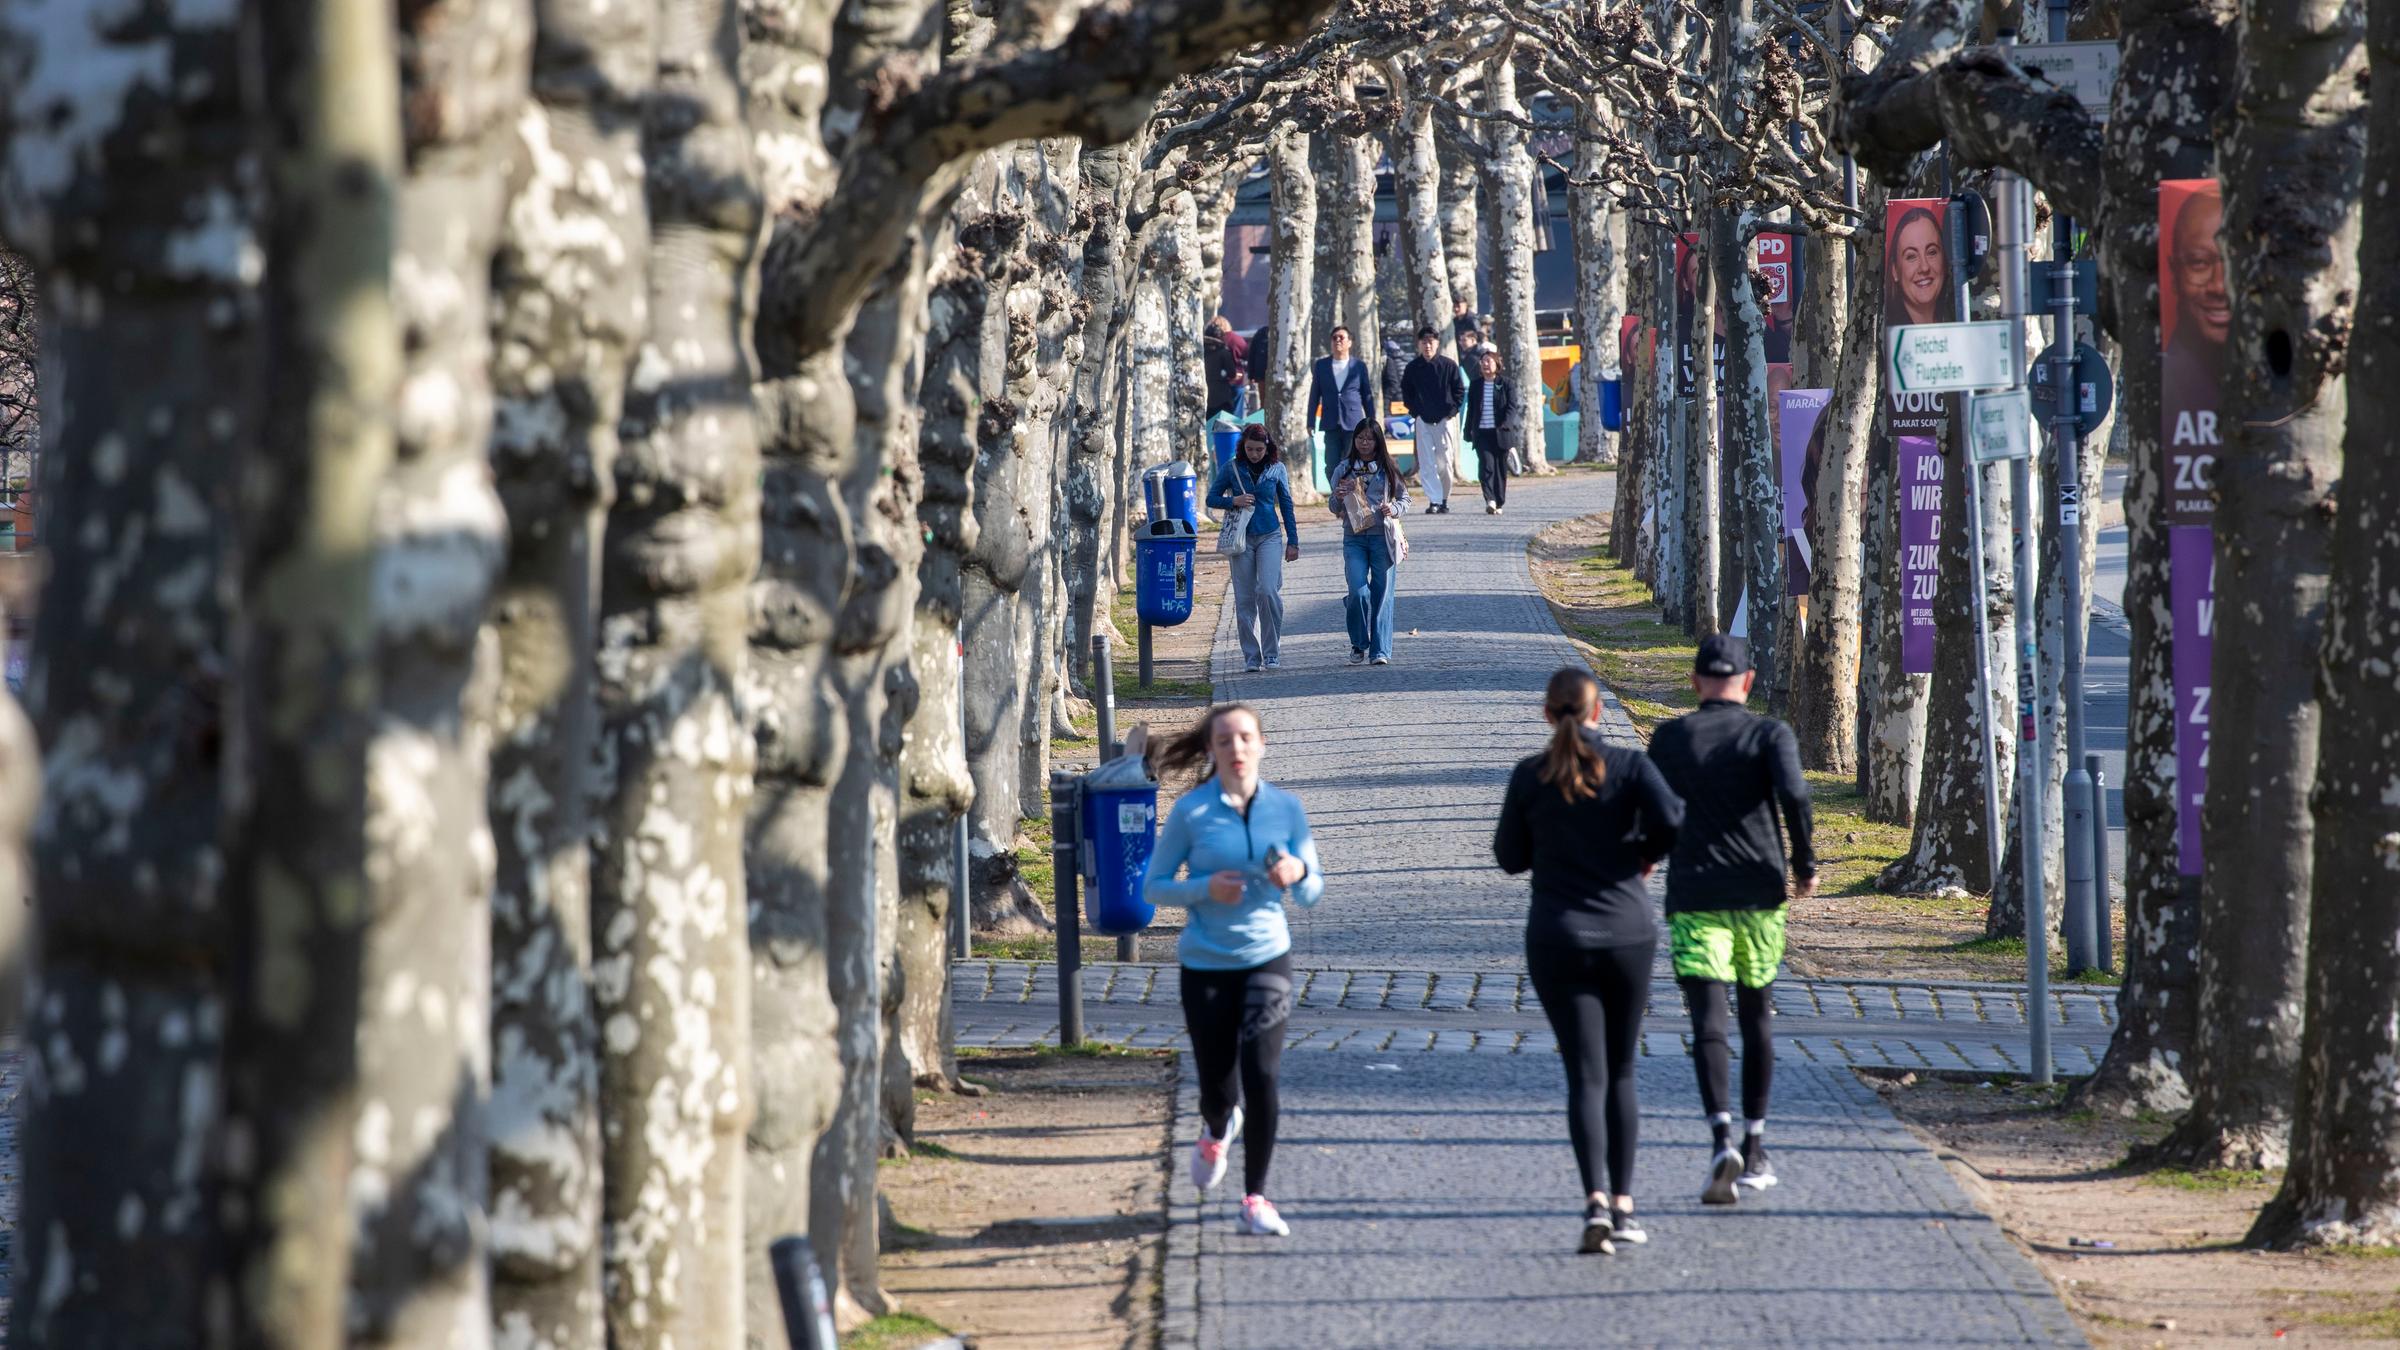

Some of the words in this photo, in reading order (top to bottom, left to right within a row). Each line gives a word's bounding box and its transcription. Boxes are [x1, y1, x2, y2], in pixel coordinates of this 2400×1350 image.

[1915, 336, 1948, 353] Höchst
[1916, 362, 1963, 384] Flughafen
[1786, 398, 1820, 409] MARAL
[1893, 419, 1919, 428] PLAKAT
[2173, 411, 2223, 445] AR
[1911, 485, 1942, 510] WIR
[2097, 771, 2105, 786] 2
